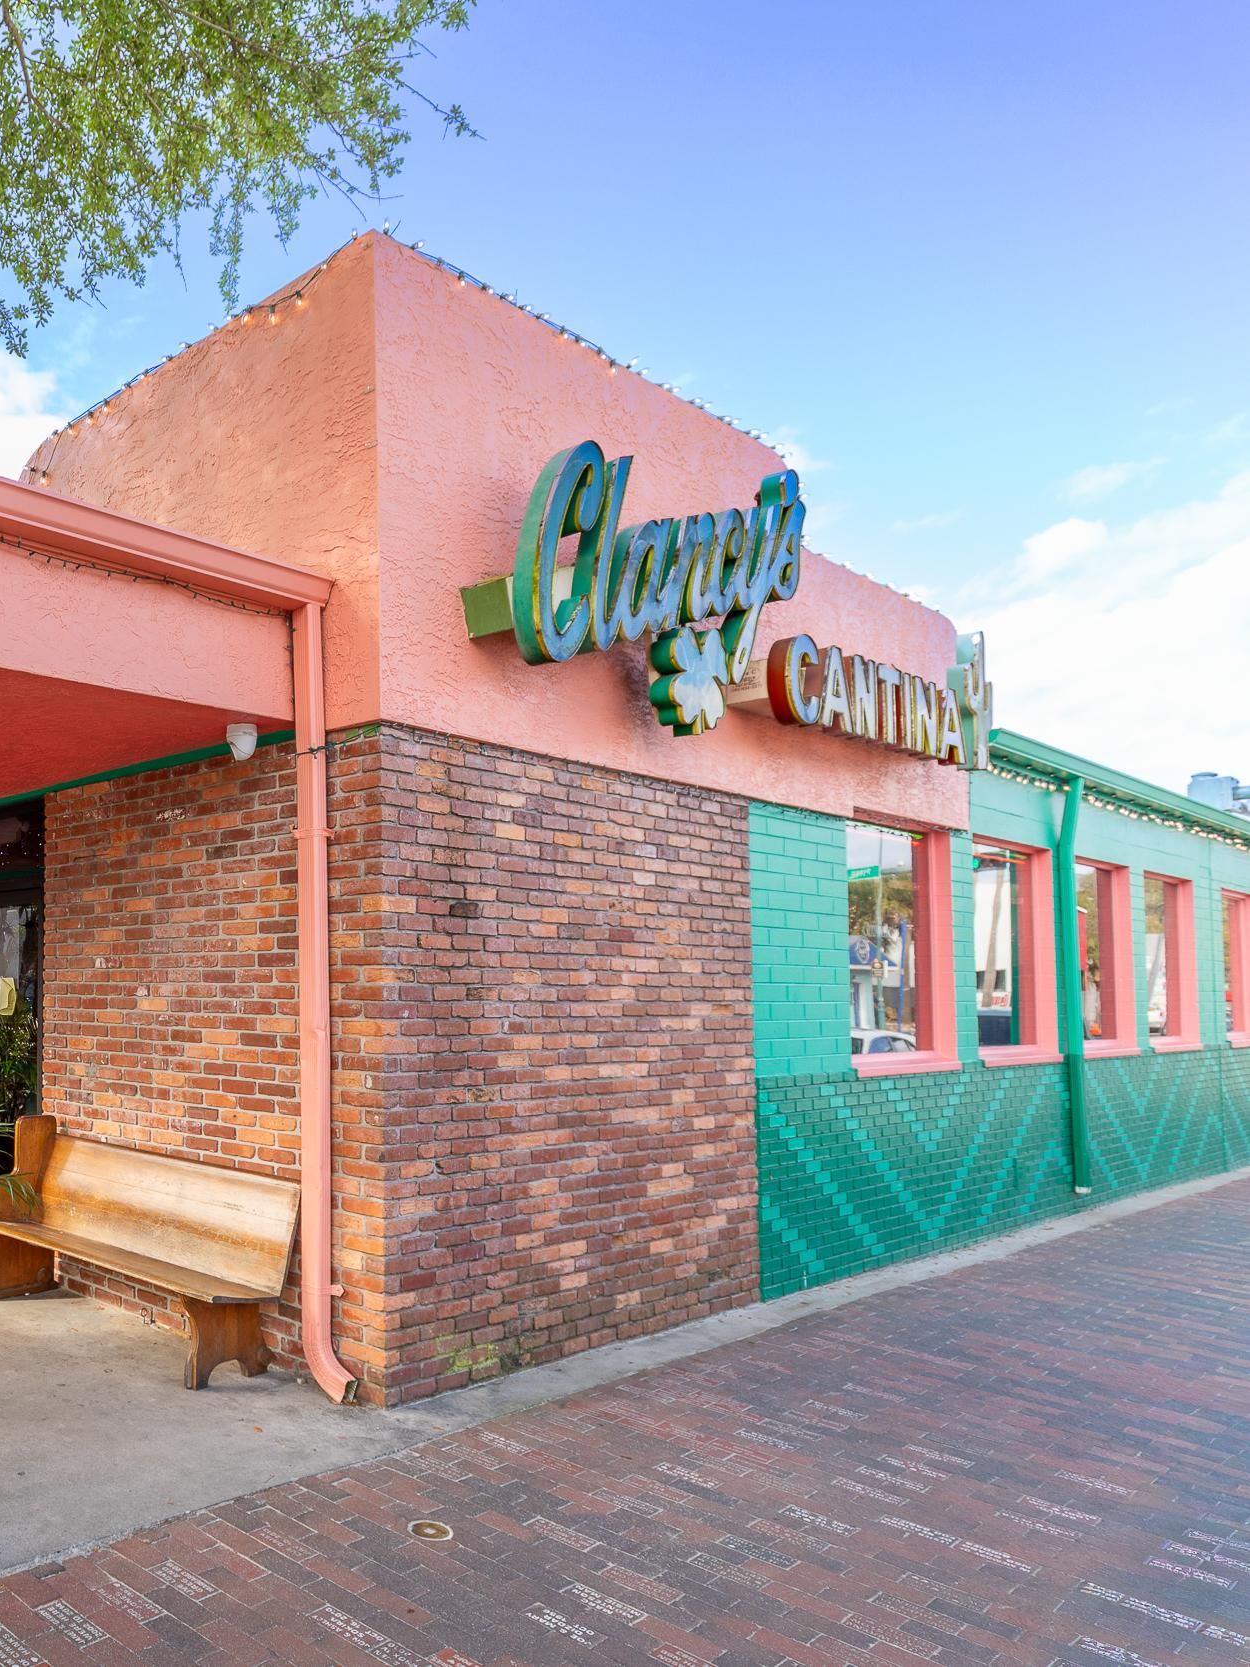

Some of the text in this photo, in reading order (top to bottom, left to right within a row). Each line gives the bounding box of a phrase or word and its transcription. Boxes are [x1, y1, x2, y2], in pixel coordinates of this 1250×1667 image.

[516, 440, 807, 685] Clancy's
[769, 633, 967, 766] CANTINA
[573, 1584, 603, 1598] MAN
[570, 1588, 634, 1618] MONTESON
[578, 1597, 614, 1614] MARC
[603, 1598, 642, 1616] MUSIC
[72, 1615, 83, 1623] TO
[324, 1607, 348, 1620] 2010
[524, 1611, 557, 1628] MARY
[47, 1605, 93, 1640] WERE HERE
[311, 1614, 343, 1632] ASHLEY
[1, 1633, 30, 1655] HANKS
[569, 1634, 592, 1646] JOE
[18, 1658, 30, 1666] OF
